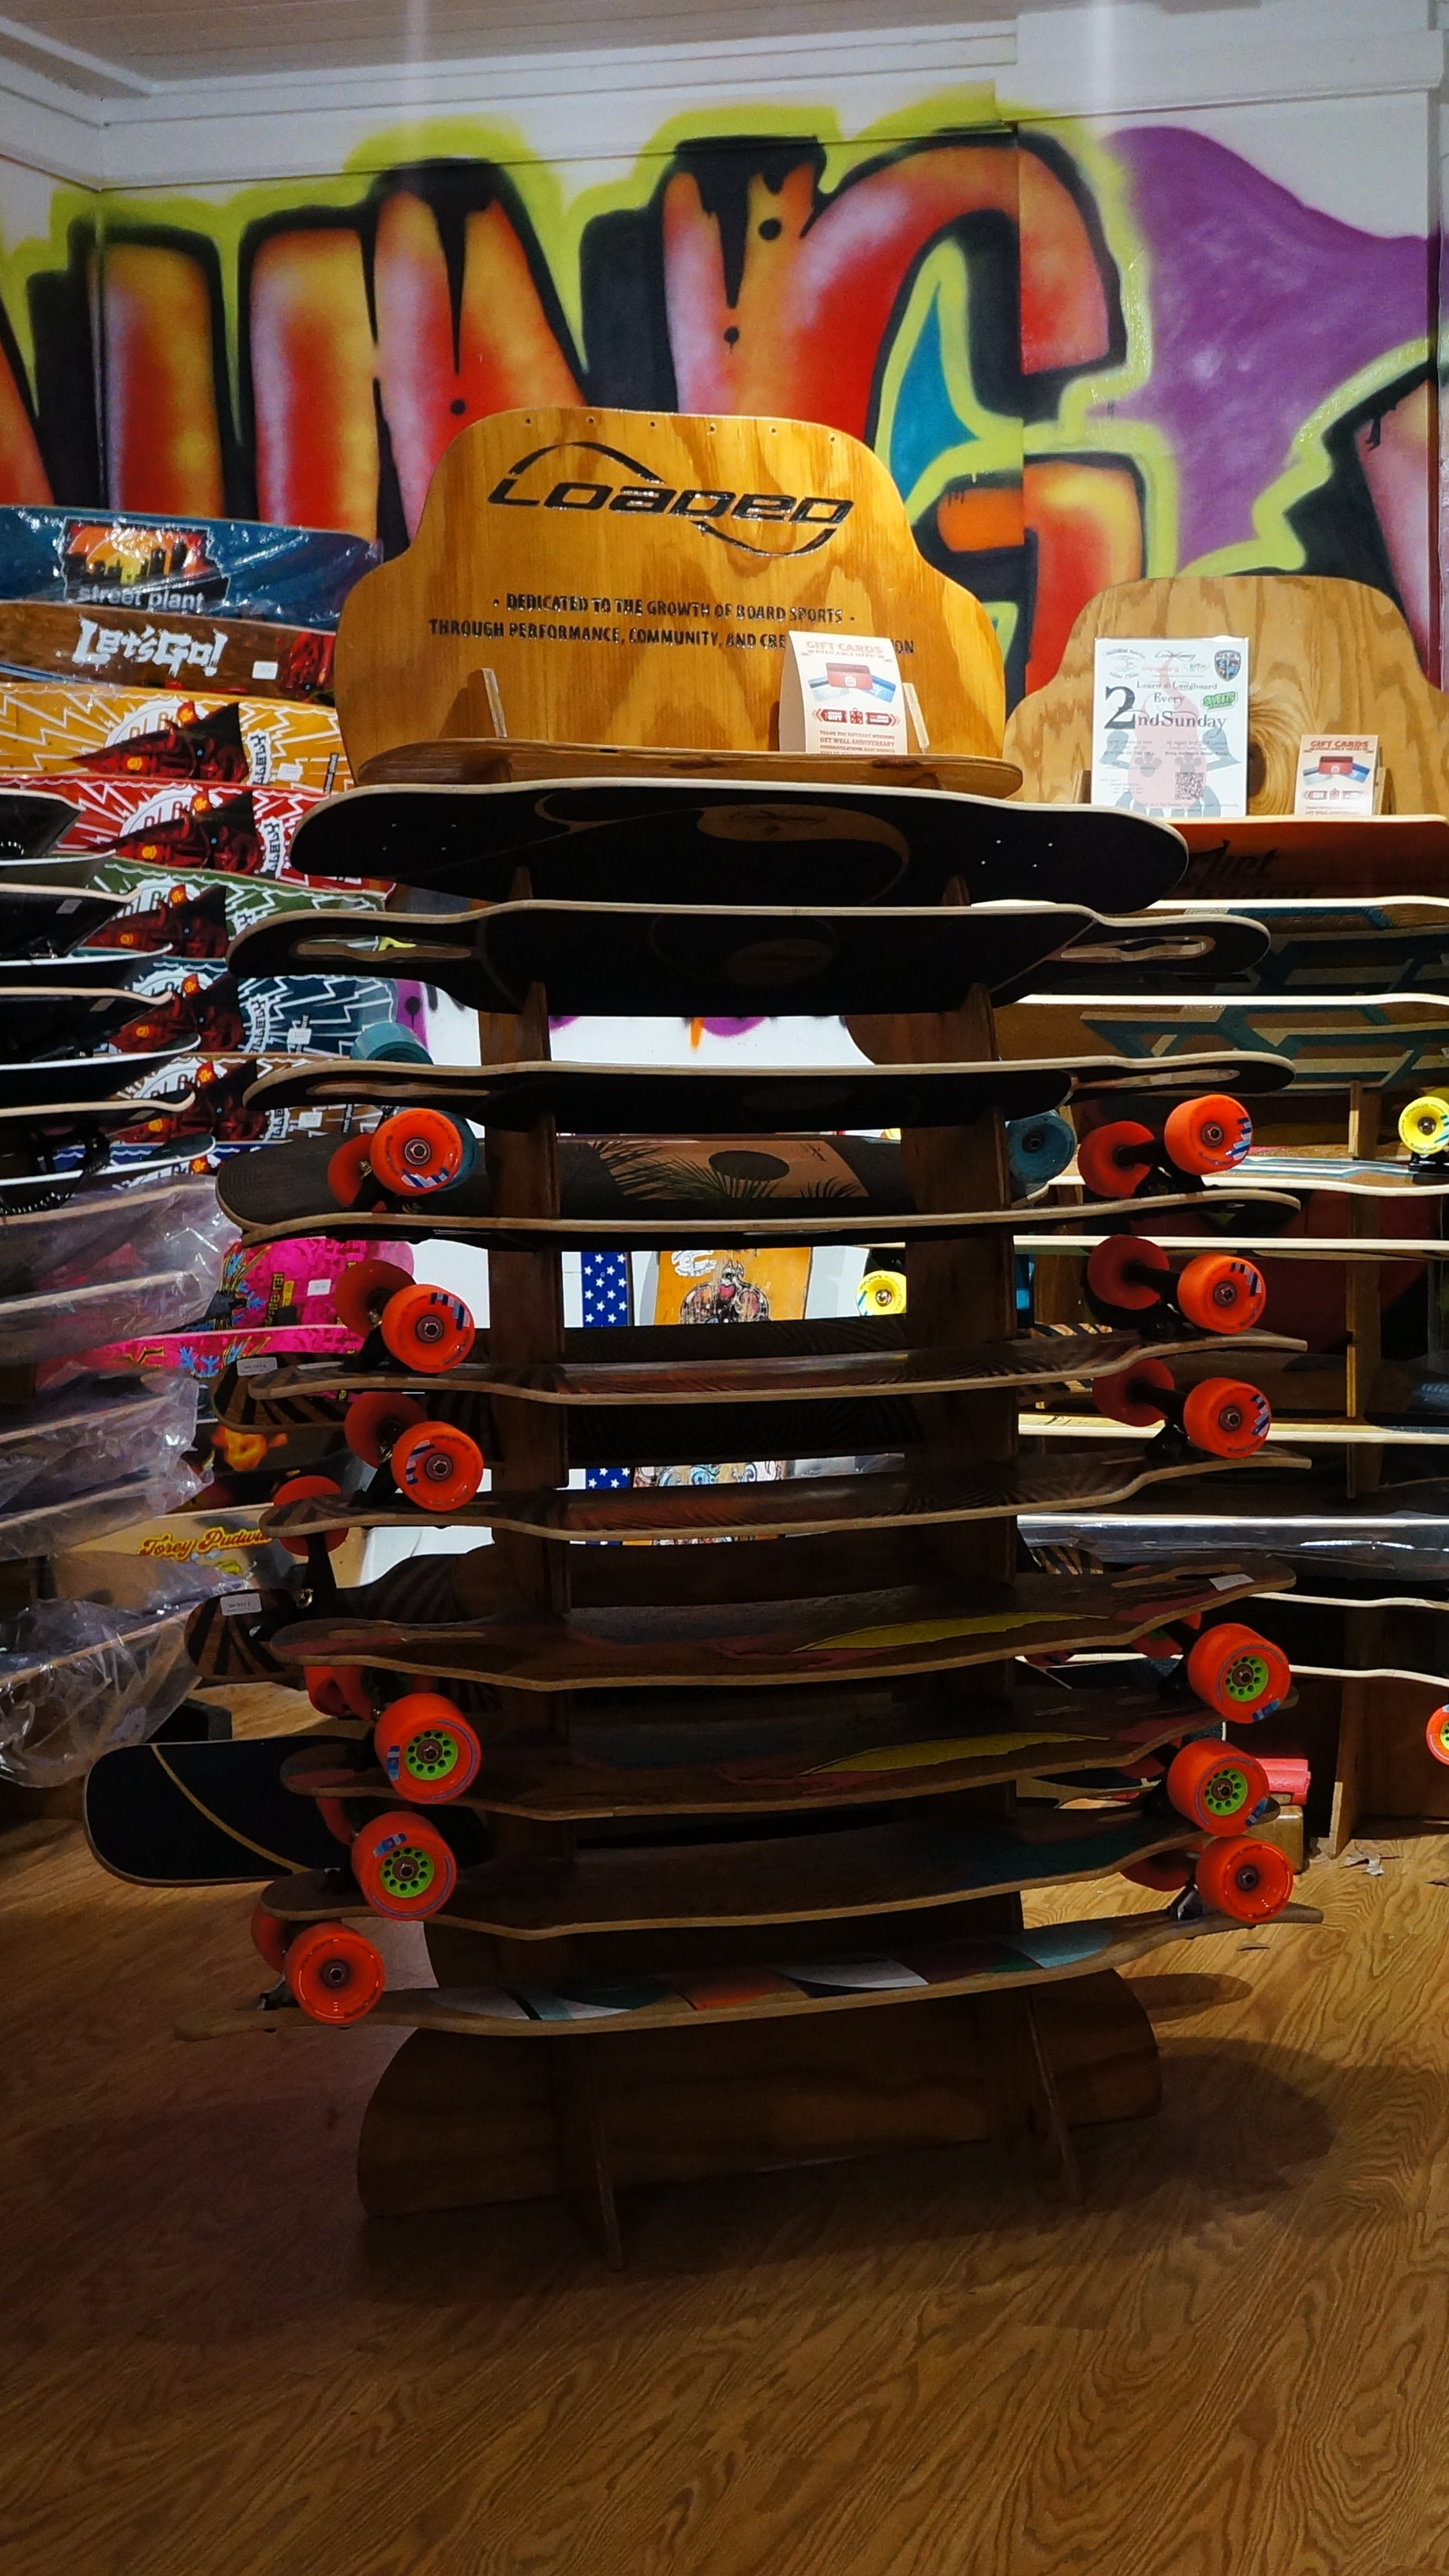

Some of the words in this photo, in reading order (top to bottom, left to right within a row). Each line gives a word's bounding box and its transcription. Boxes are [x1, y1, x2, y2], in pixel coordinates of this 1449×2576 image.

[79, 584, 142, 606] street
[146, 589, 204, 614] plant
[506, 593, 588, 615] DEDICATED
[592, 597, 611, 615] TO
[615, 599, 642, 616] THE
[646, 601, 710, 619] GROWTH
[714, 603, 732, 620] OF
[736, 605, 786, 622] BOARD
[789, 607, 843, 624] SPORTS
[429, 618, 504, 638] THROUGH
[509, 622, 626, 645] PERFORMANCE,
[629, 627, 722, 649] COMMUNITY,
[726, 632, 757, 650] AND
[806, 640, 835, 652] GIFT
[838, 642, 884, 654] CARDS
[1136, 680, 1161, 689] Learn
[1154, 691, 1185, 704] Every
